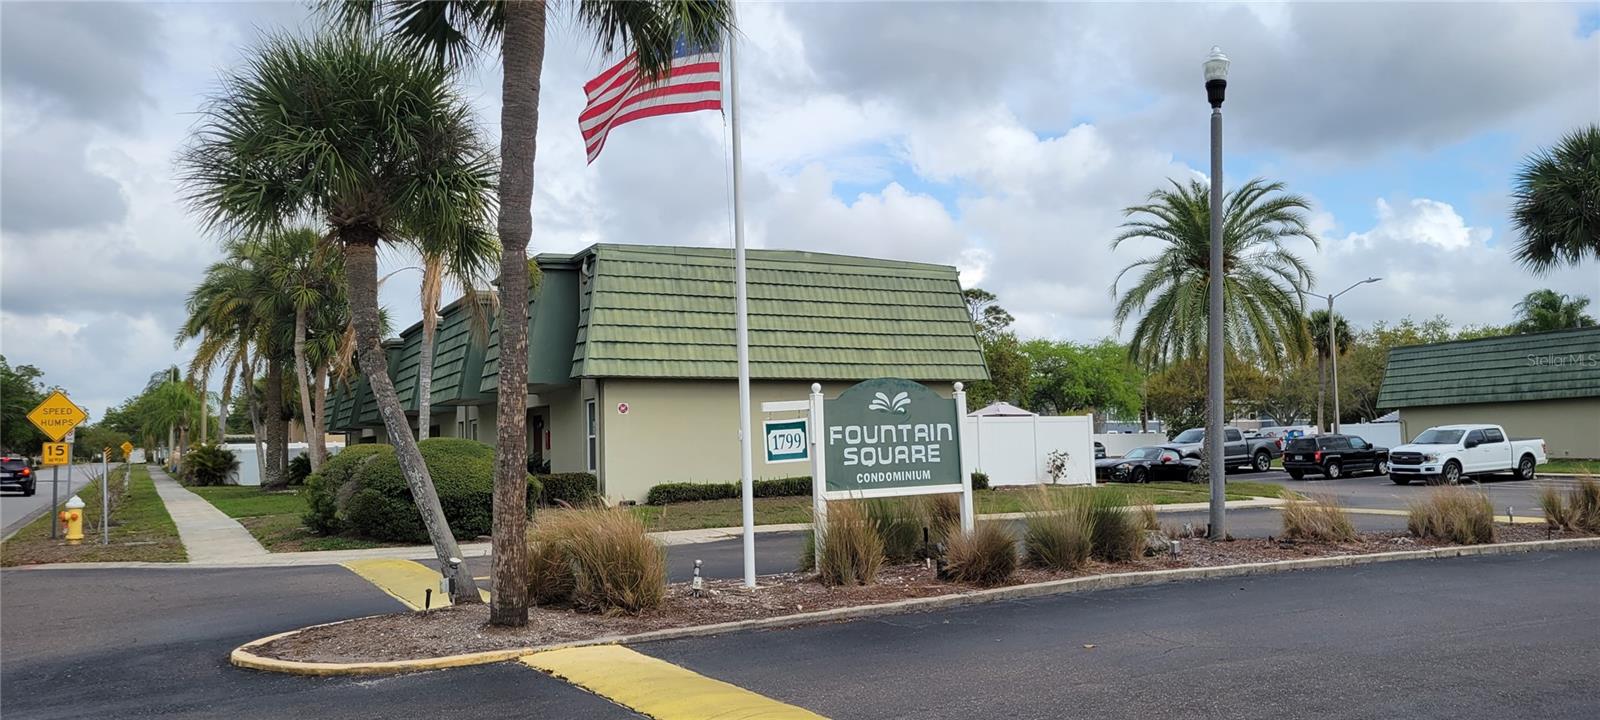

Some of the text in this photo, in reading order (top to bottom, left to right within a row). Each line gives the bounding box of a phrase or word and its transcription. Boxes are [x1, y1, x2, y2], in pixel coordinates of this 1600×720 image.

[42, 407, 73, 416] SPEED
[41, 419, 74, 427] HUMPS
[829, 423, 953, 445] FOUNTAIN
[772, 433, 802, 450] 1799
[47, 445, 65, 456] 15
[843, 444, 941, 467] SQUARE
[856, 470, 931, 484] CONDOMINIUM
